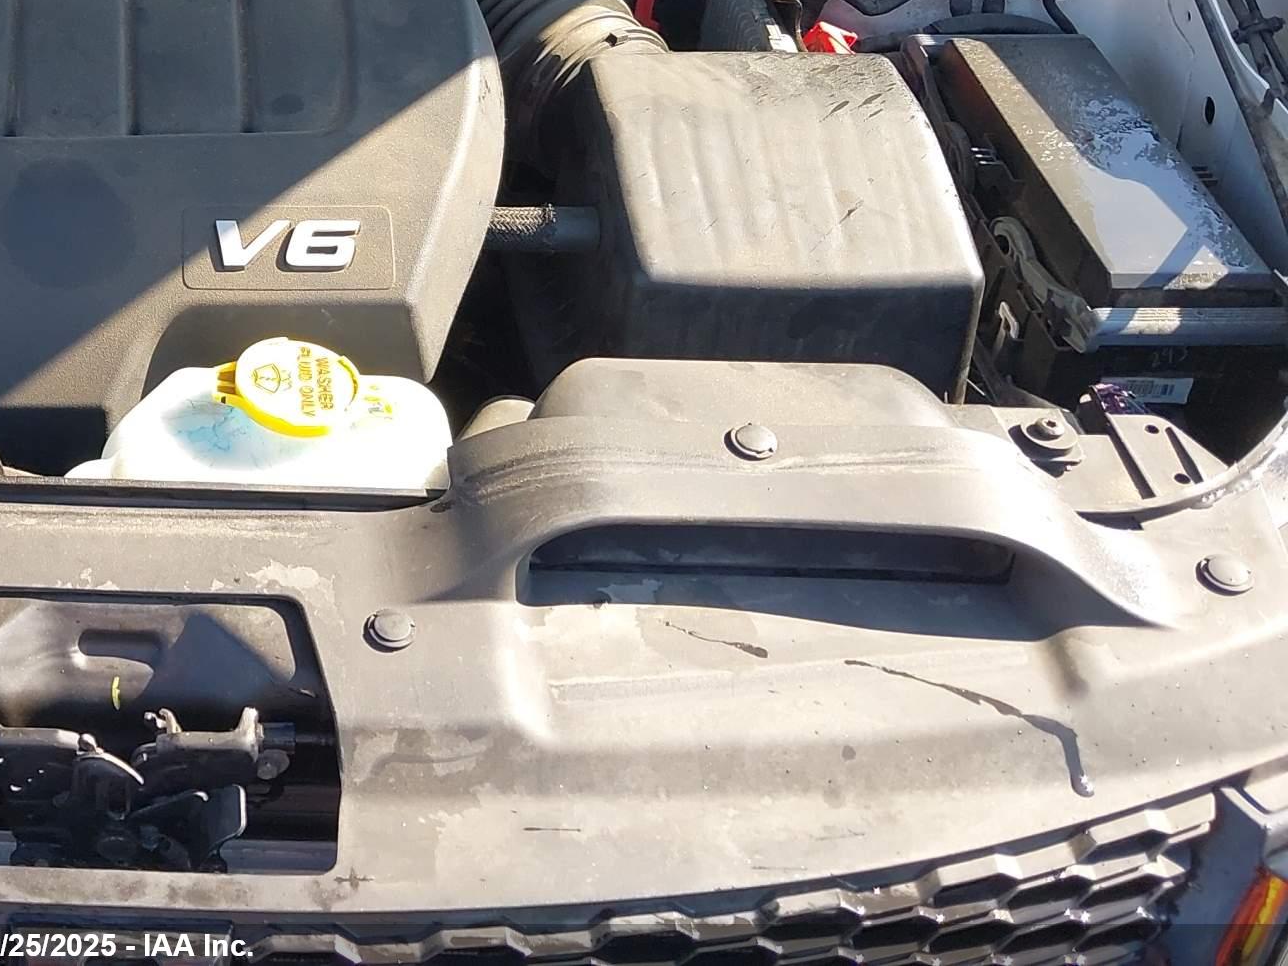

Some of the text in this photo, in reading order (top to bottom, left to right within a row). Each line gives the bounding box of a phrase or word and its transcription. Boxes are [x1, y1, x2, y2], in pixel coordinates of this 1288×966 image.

[215, 219, 361, 268] V6
[297, 346, 316, 417] FLUID ONLY
[315, 357, 334, 410] WASHER
